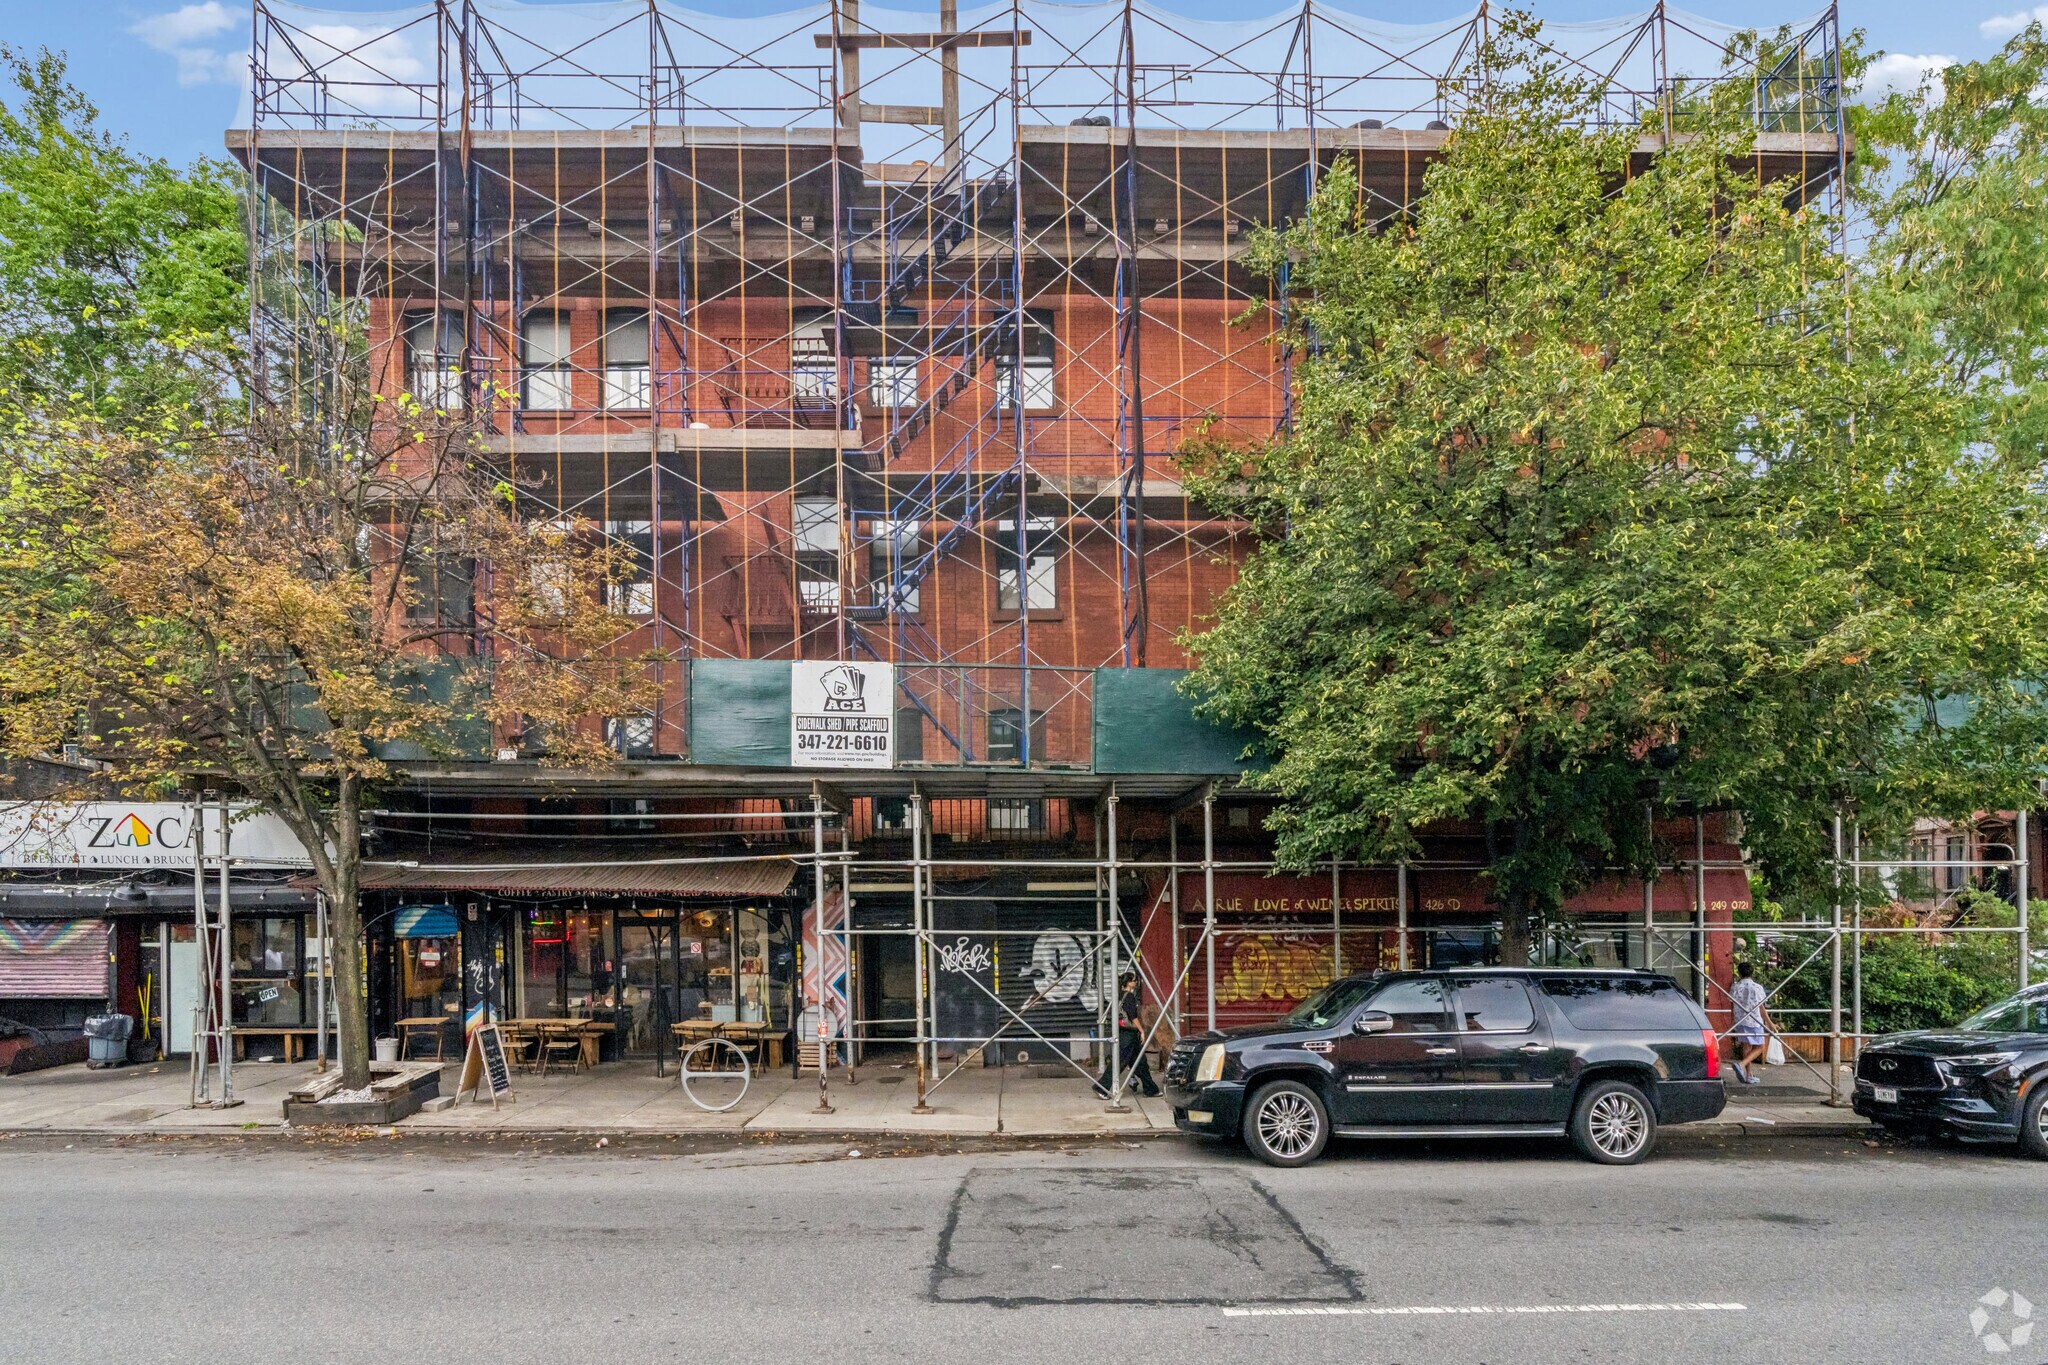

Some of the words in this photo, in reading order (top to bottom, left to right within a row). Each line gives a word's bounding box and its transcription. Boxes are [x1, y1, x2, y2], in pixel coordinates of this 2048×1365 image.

[826, 698, 863, 711] ACE
[797, 717, 827, 730] SIDEWALK
[827, 718, 842, 731] SHED
[845, 718, 859, 731] PIPE
[859, 719, 888, 732] SCAFFOLD
[798, 734, 887, 751] 347-221-6610
[101, 855, 139, 864] LUNCH
[1192, 899, 1205, 911] A
[1215, 899, 1243, 911] RUE
[1254, 899, 1290, 911] LOVE
[1425, 899, 1445, 910] 426
[1711, 900, 1727, 911] 249
[1731, 900, 1749, 910] 0721
[260, 987, 278, 999] OPEN
